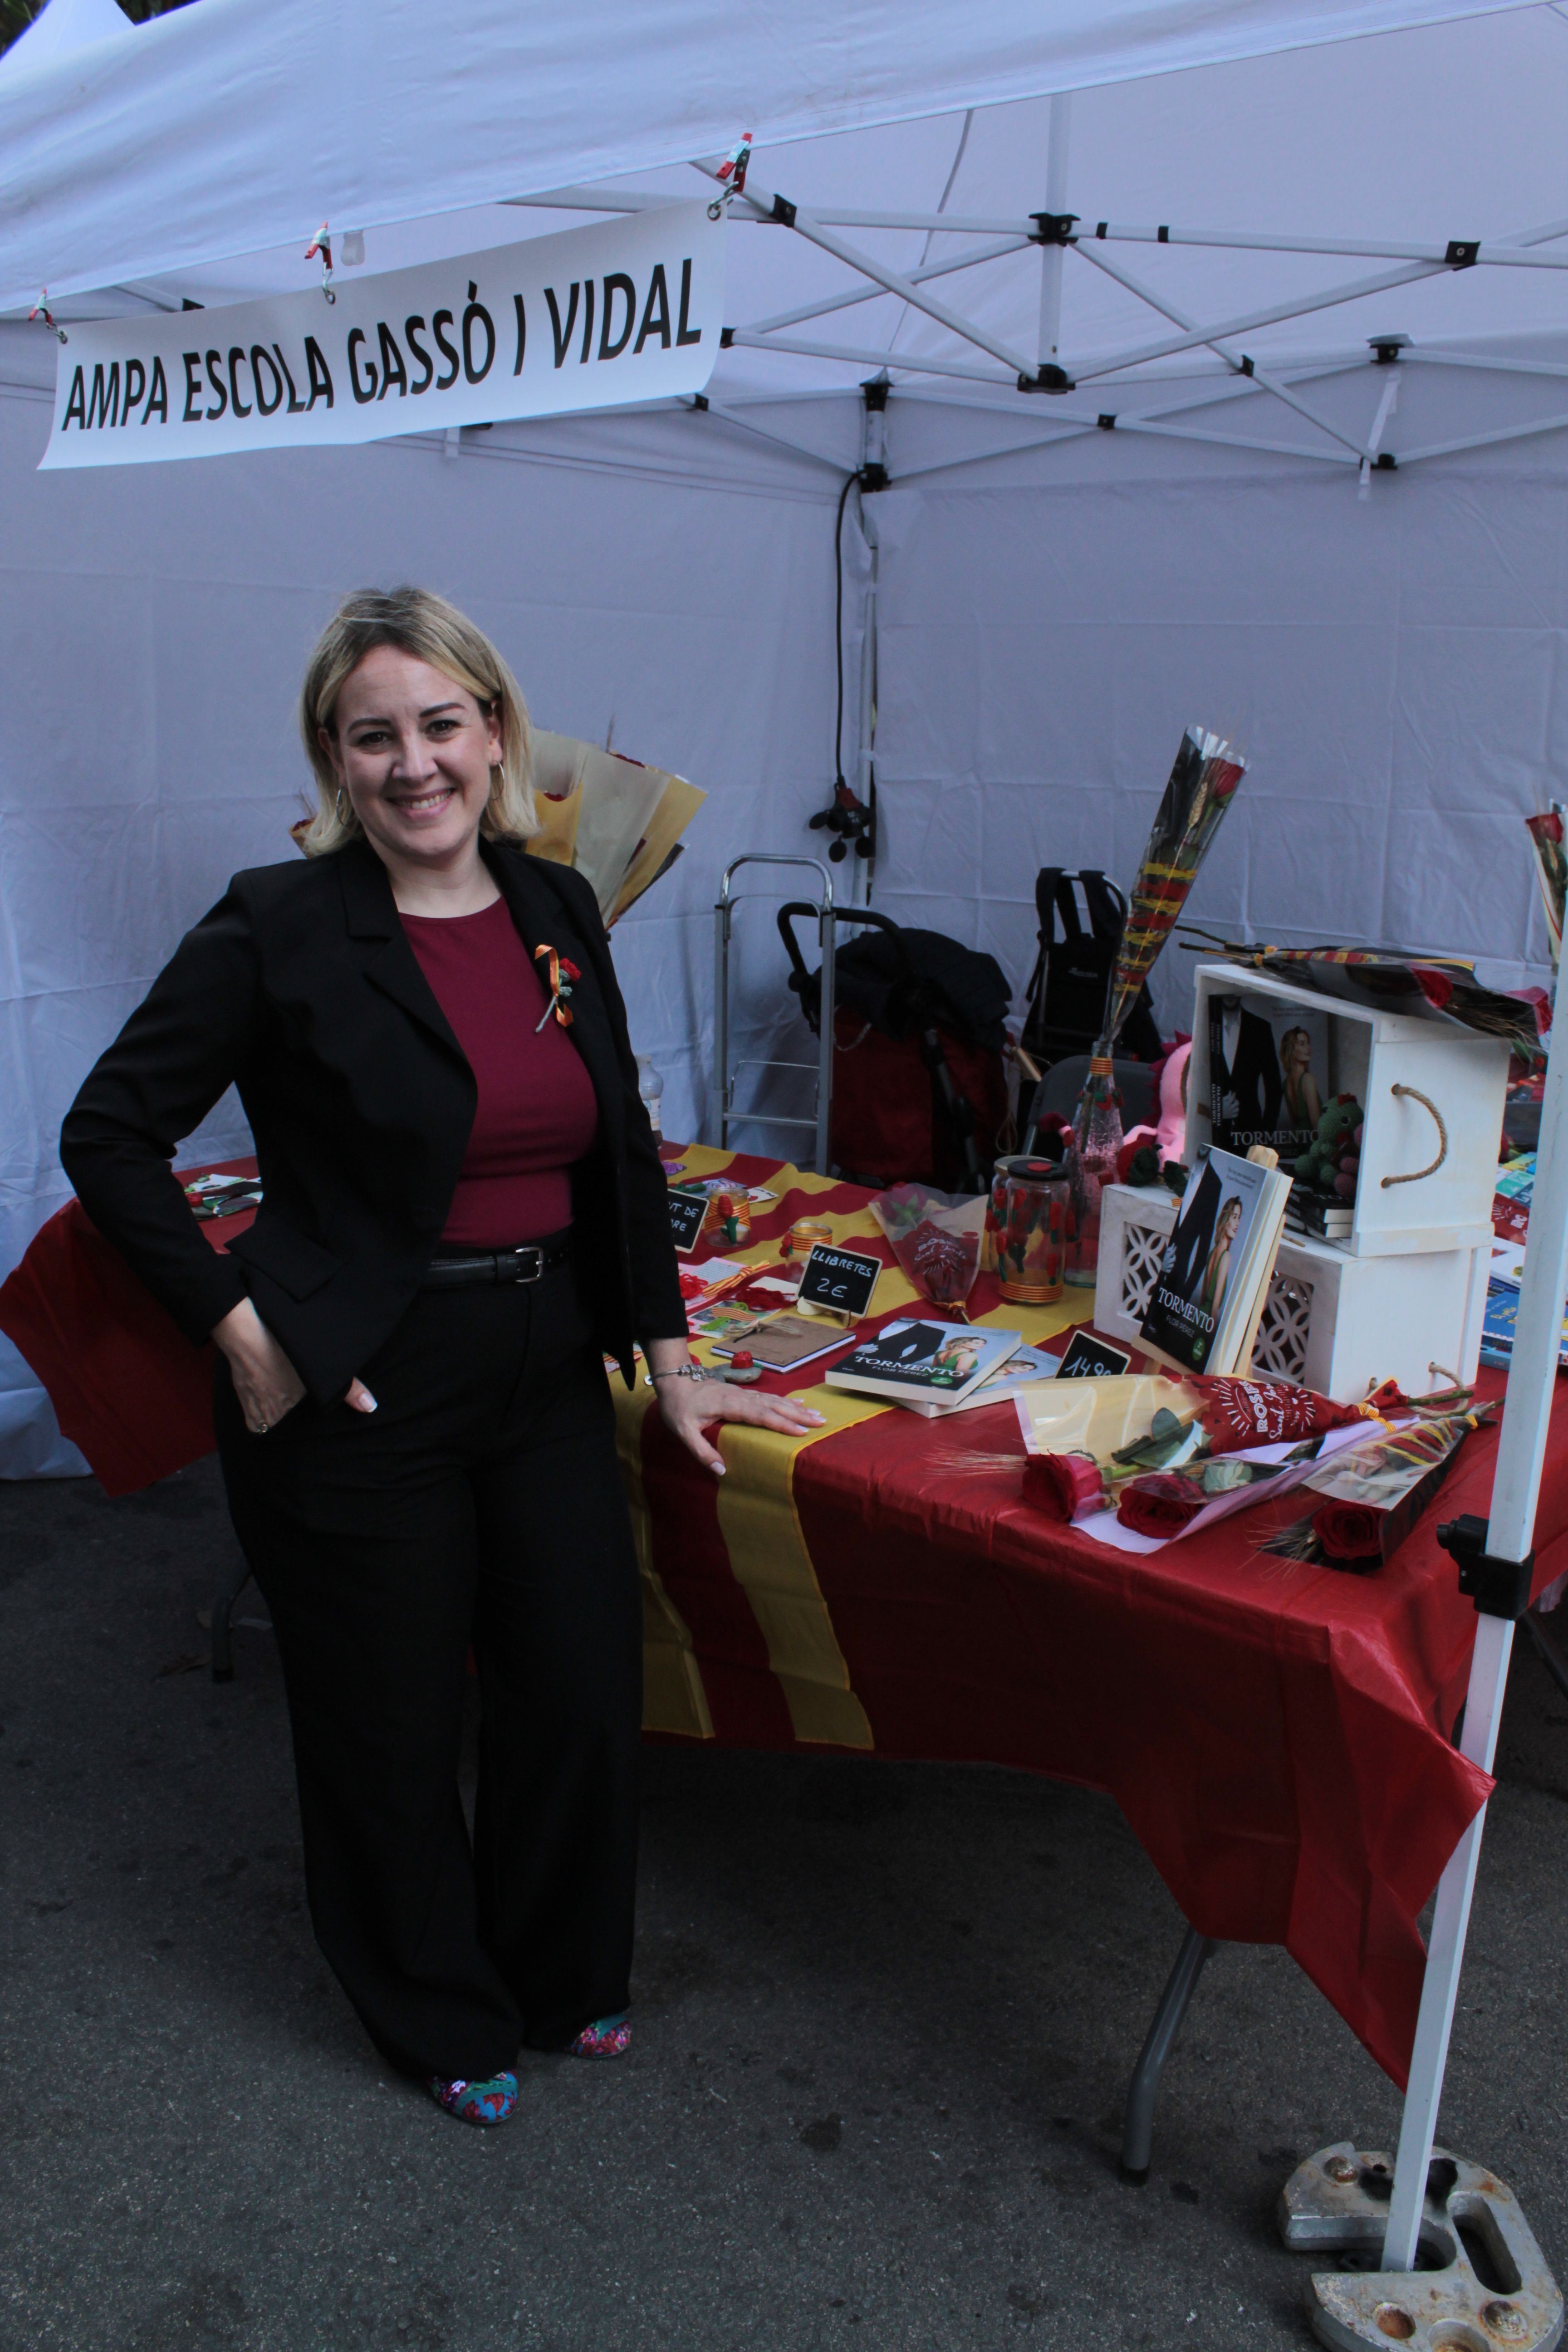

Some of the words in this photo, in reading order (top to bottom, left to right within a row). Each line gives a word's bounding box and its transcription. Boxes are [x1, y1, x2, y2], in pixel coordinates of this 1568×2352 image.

[62, 355, 168, 431] AMPA
[182, 336, 334, 423] ESCOLA
[347, 279, 496, 404] GASSÓ
[513, 294, 526, 376] I
[544, 258, 701, 369] VIDAL
[1230, 1130, 1320, 1146] TORMENTO
[684, 1206, 699, 1218] DE
[811, 1250, 872, 1278] LLIBRETES
[817, 1278, 848, 1298] 2€
[1158, 1287, 1215, 1333] TORMENTO
[1166, 1314, 1180, 1328] FLOR
[854, 1355, 964, 1377] TORMENTO
